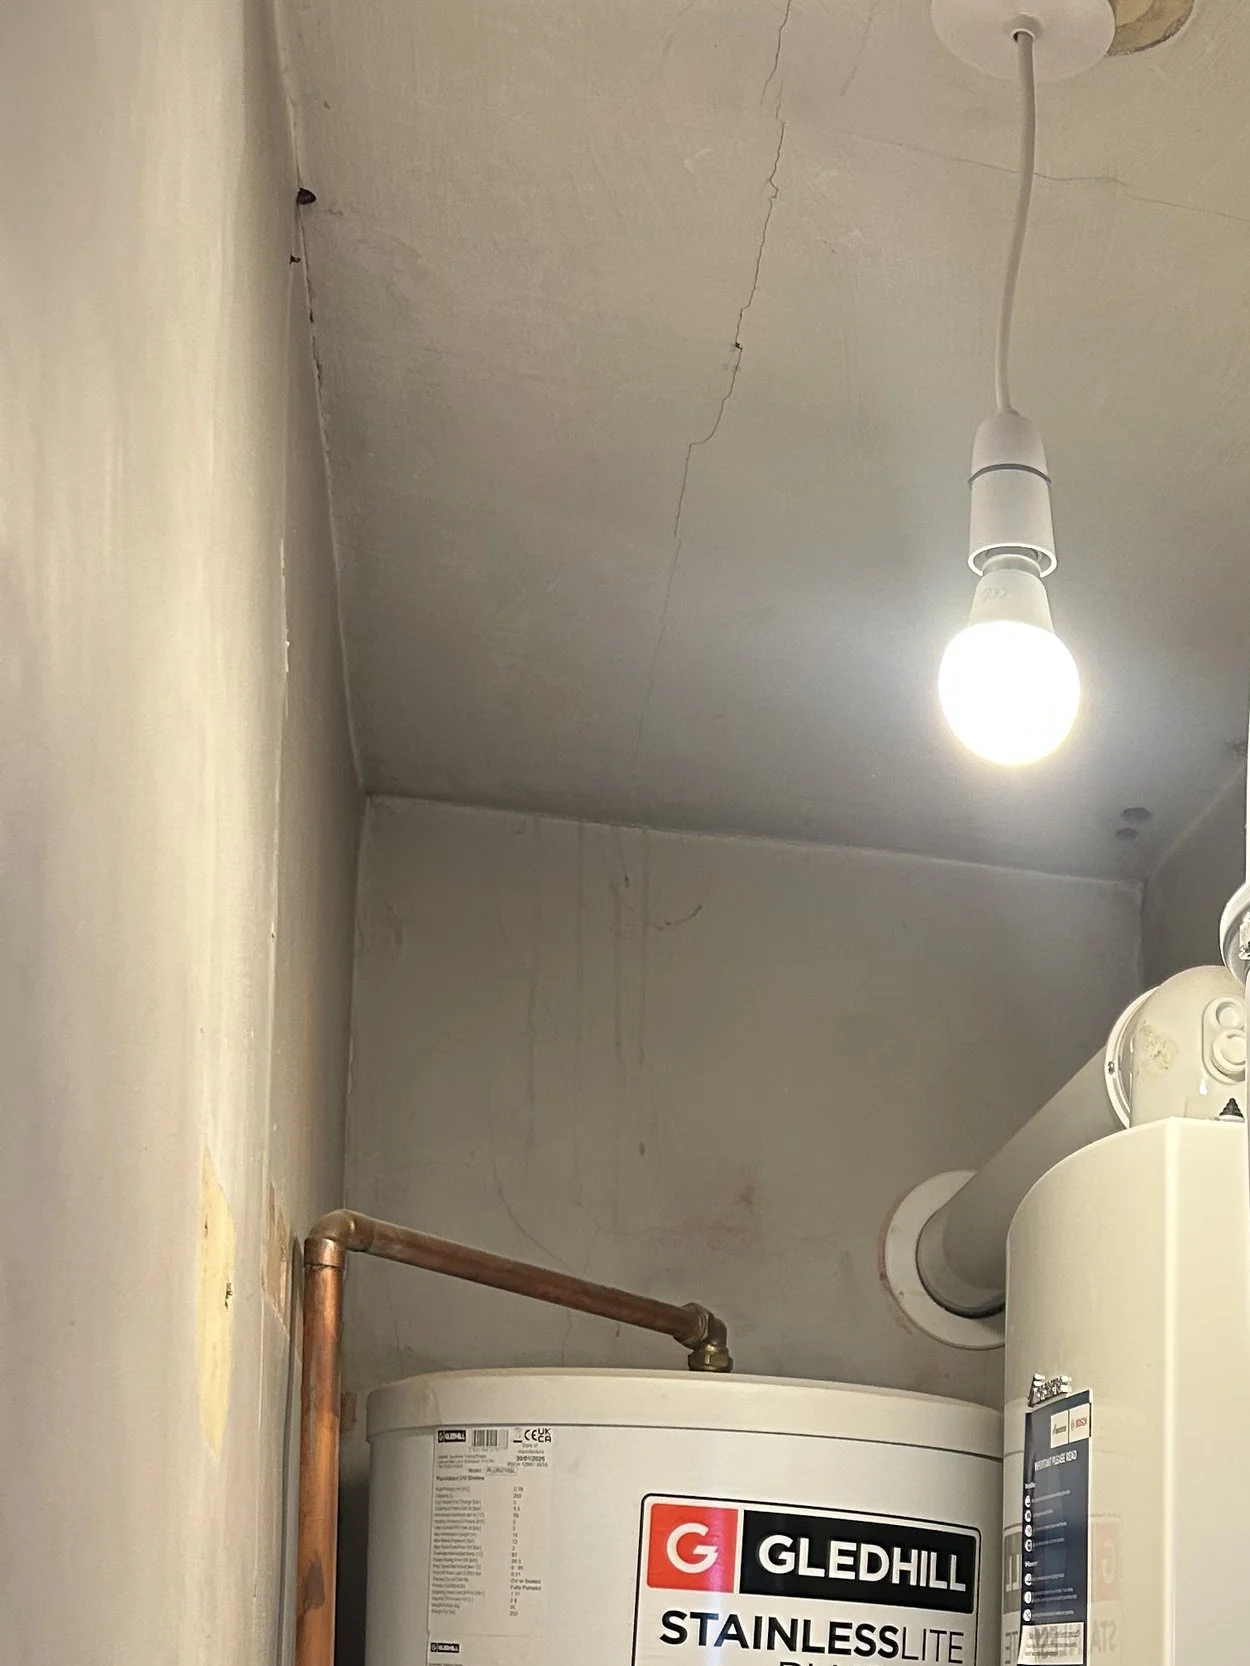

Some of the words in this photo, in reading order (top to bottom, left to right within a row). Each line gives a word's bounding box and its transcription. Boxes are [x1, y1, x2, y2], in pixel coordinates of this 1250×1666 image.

[666, 1522, 719, 1574] G
[758, 1535, 967, 1592] GLEDHILL
[660, 1610, 964, 1664] STAINLESSLITE
